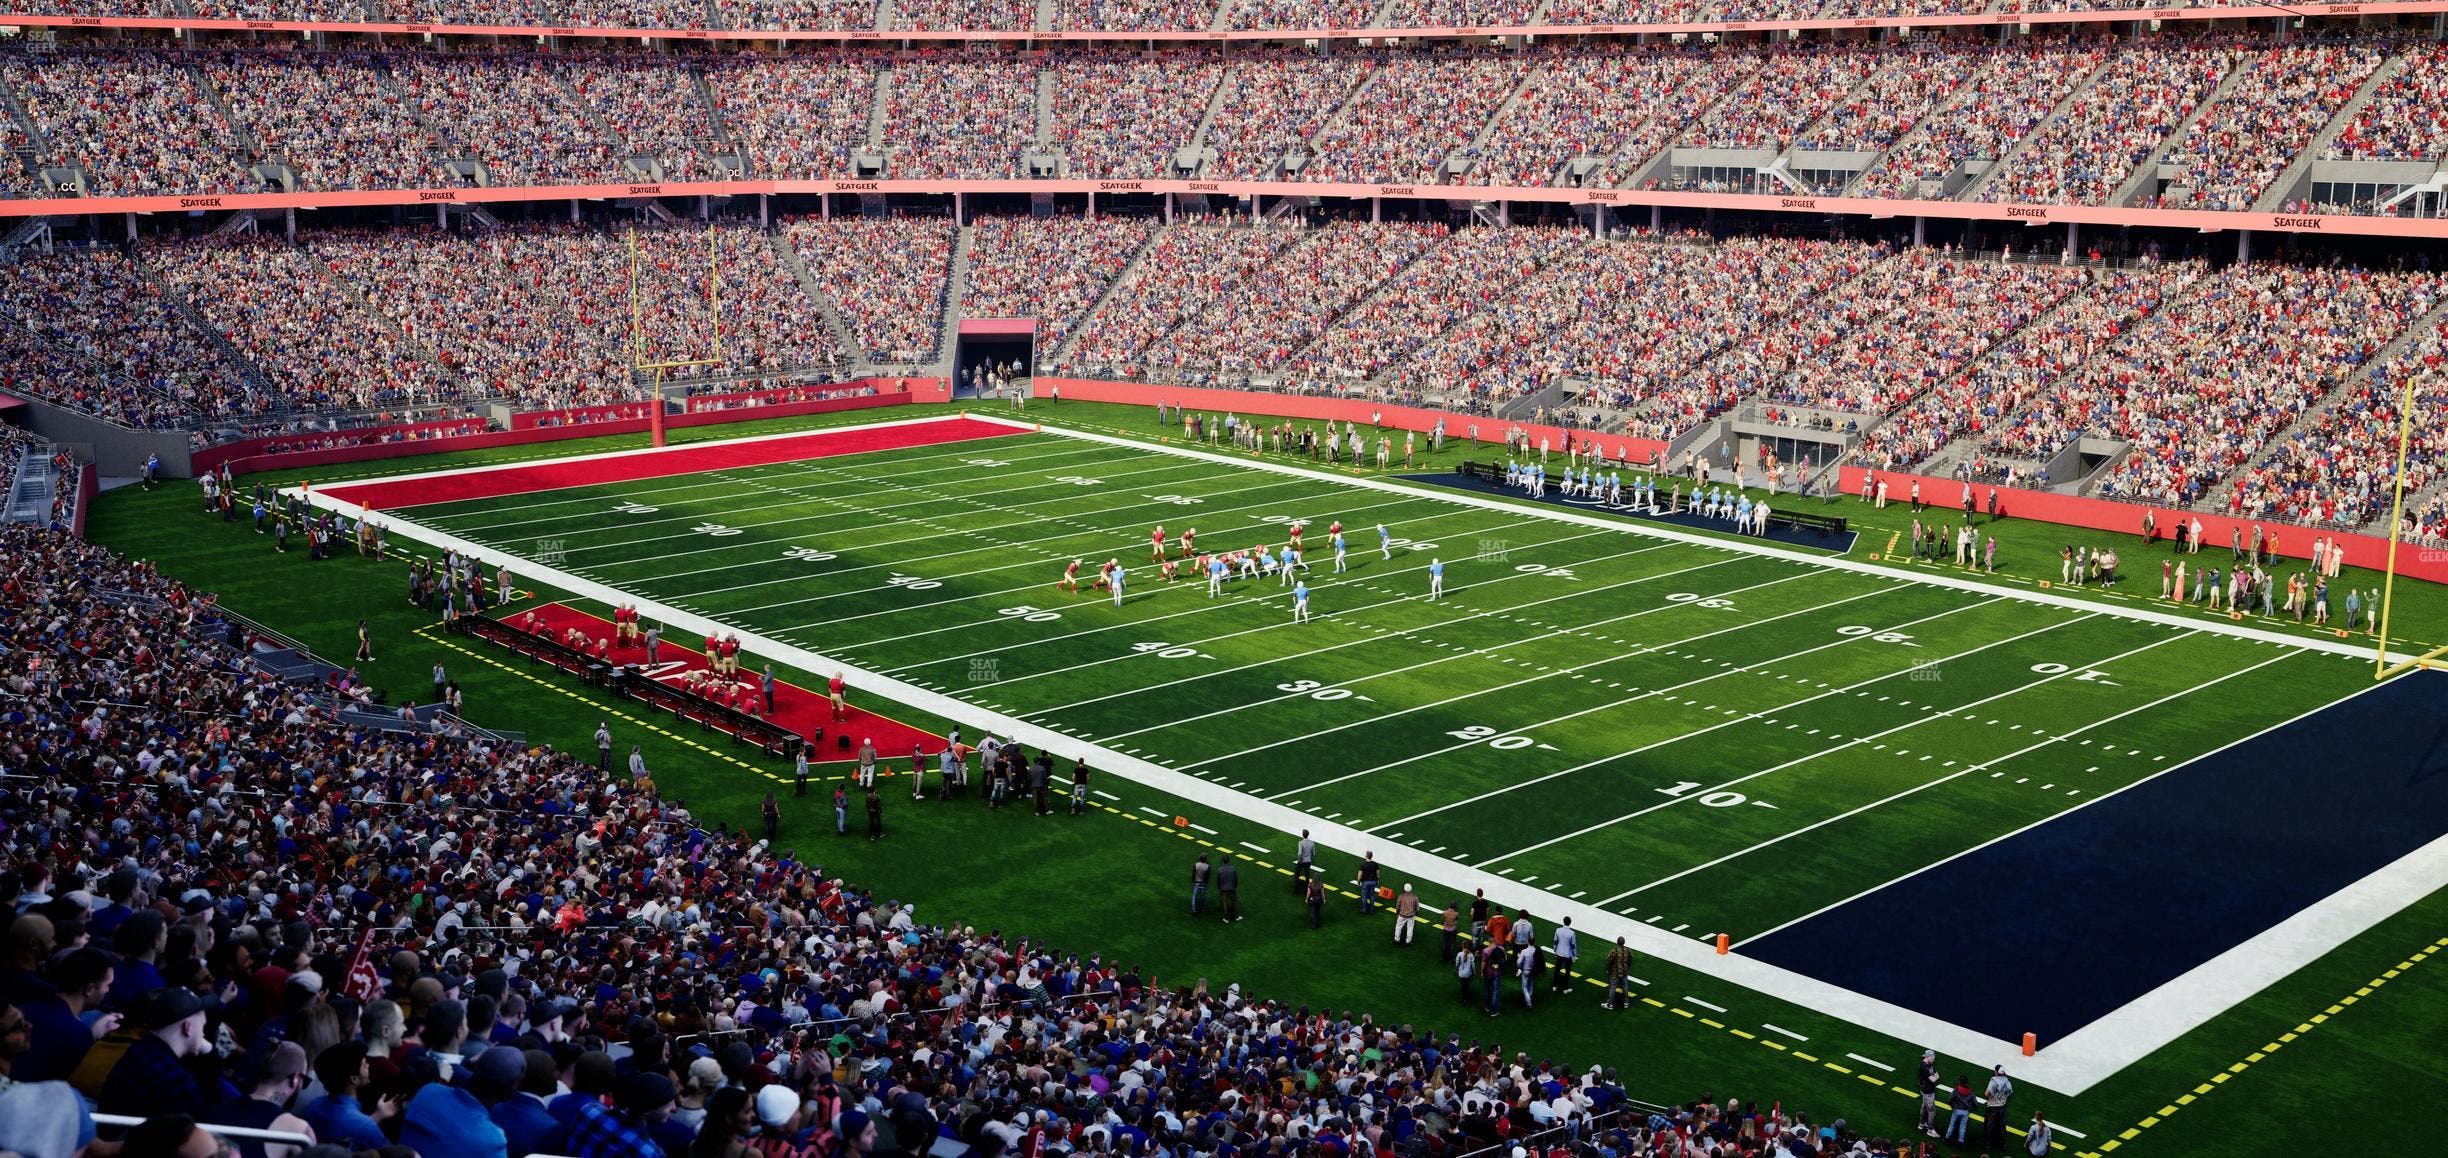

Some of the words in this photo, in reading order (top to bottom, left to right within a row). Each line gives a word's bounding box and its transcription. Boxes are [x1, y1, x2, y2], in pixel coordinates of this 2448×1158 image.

[2153, 10, 2181, 18] SEATGEEK
[2329, 5, 2360, 13] SEATGEEK
[1996, 15, 2021, 23] SEATGEEK
[247, 21, 274, 29] SEATGEEK
[629, 186, 661, 194] SEATGEEK
[836, 183, 878, 191] SEATGEEK
[1100, 182, 1142, 190] SEATGEEK
[1189, 183, 1219, 191] SEATGEEK
[420, 192, 456, 201] SEATGEEK
[1381, 187, 1414, 196] SEATGEEK
[1589, 191, 1618, 201] SEATGEEK
[181, 198, 222, 208] SEATGEEK
[1782, 199, 1816, 209] SEATGEEK
[2007, 207, 2047, 218] SEATGEEK
[2274, 217, 2321, 229] SEATGEEK
[1153, 495, 1205, 505] 30
[611, 504, 660, 514] 10
[689, 524, 744, 537] 20
[782, 548, 838, 562] 30
[1515, 564, 1575, 577] 40
[885, 576, 943, 590] 40
[1665, 593, 1735, 608] 30
[998, 605, 1062, 622] 50
[1836, 626, 1915, 643] 20
[1130, 642, 1198, 659] 40
[2030, 663, 2111, 681] 10
[1276, 680, 1353, 701] 30
[1445, 725, 1534, 750] 20
[1654, 781, 1747, 808] 10
